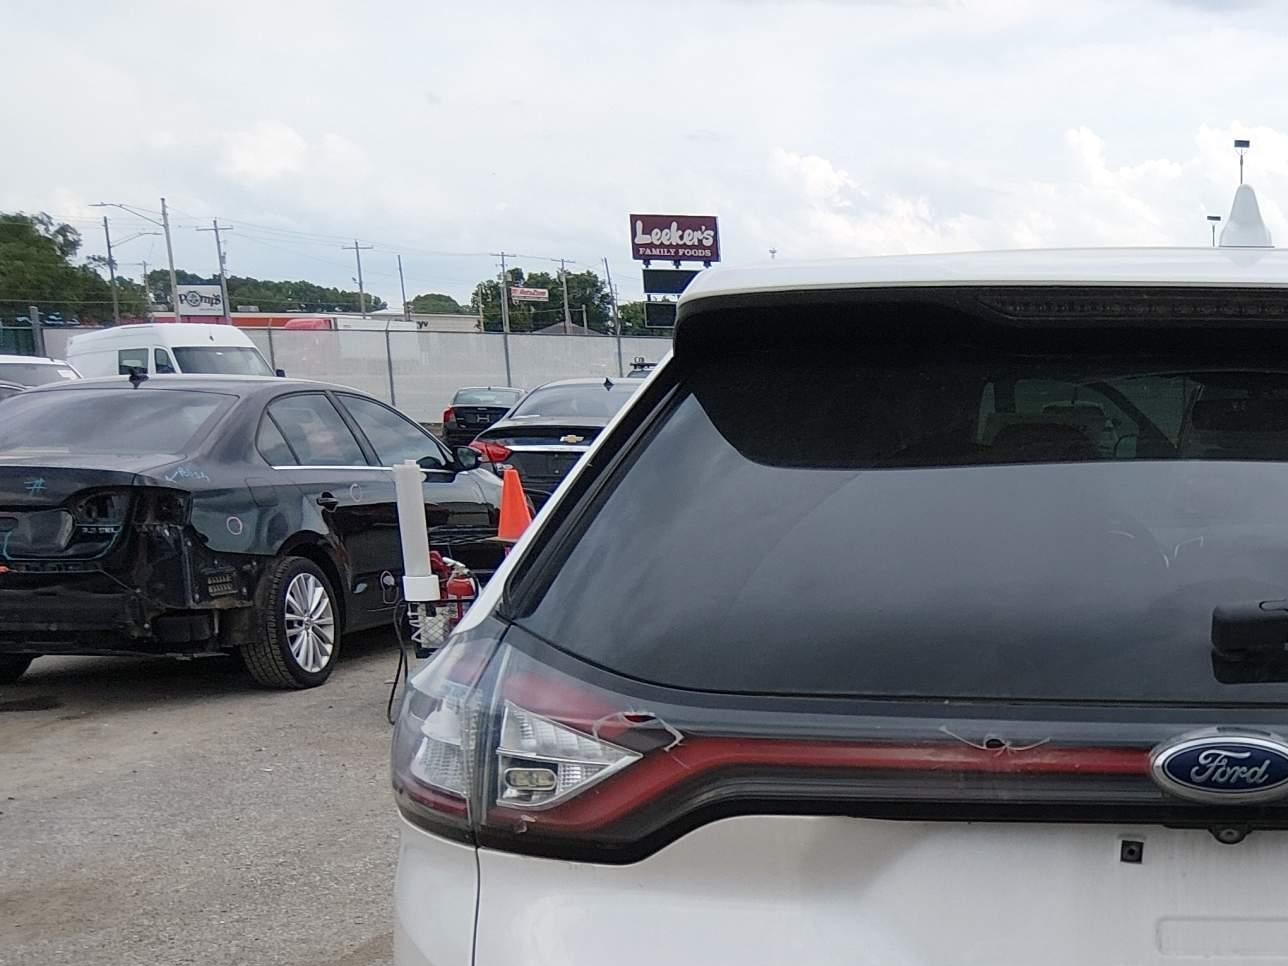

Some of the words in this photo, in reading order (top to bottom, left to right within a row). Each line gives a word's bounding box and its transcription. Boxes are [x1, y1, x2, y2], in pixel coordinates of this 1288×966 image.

[634, 220, 715, 246] Leeker's
[639, 247, 676, 256] FAMILY
[678, 248, 711, 257] FOODS
[1190, 749, 1271, 784] Ford
